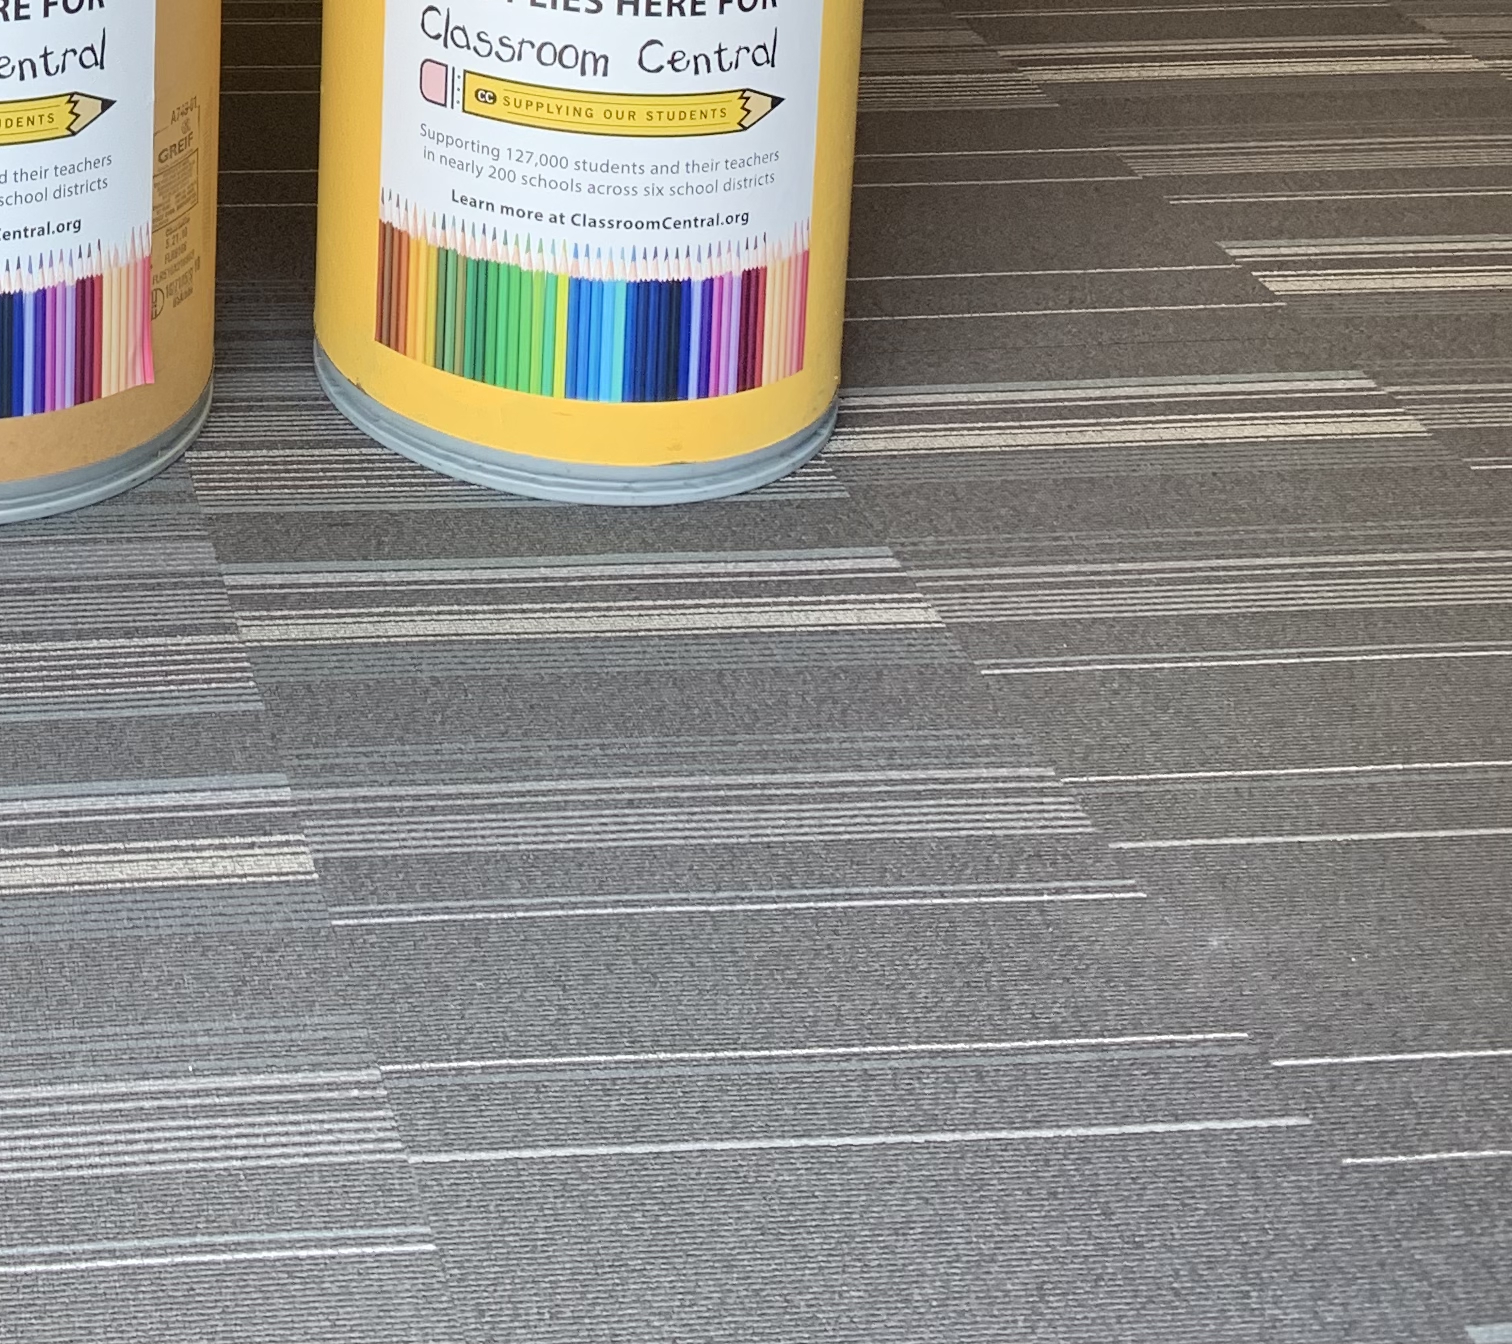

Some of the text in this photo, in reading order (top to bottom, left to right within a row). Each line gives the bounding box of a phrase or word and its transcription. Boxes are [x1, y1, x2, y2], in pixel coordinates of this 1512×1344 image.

[420, 5, 777, 77] Classroom Central
[477, 90, 727, 121] CC SUPPLYING OUR STUDENTS
[158, 131, 194, 163] GREIF
[420, 123, 779, 175] Supporting 127,000 students and their teachers
[12, 166, 50, 183] their
[53, 155, 112, 178] teachers
[424, 145, 775, 197] in nearly 200 schools across six school districts
[52, 177, 108, 200] districts
[452, 189, 749, 230] Learn more at ClassroomCentral.org
